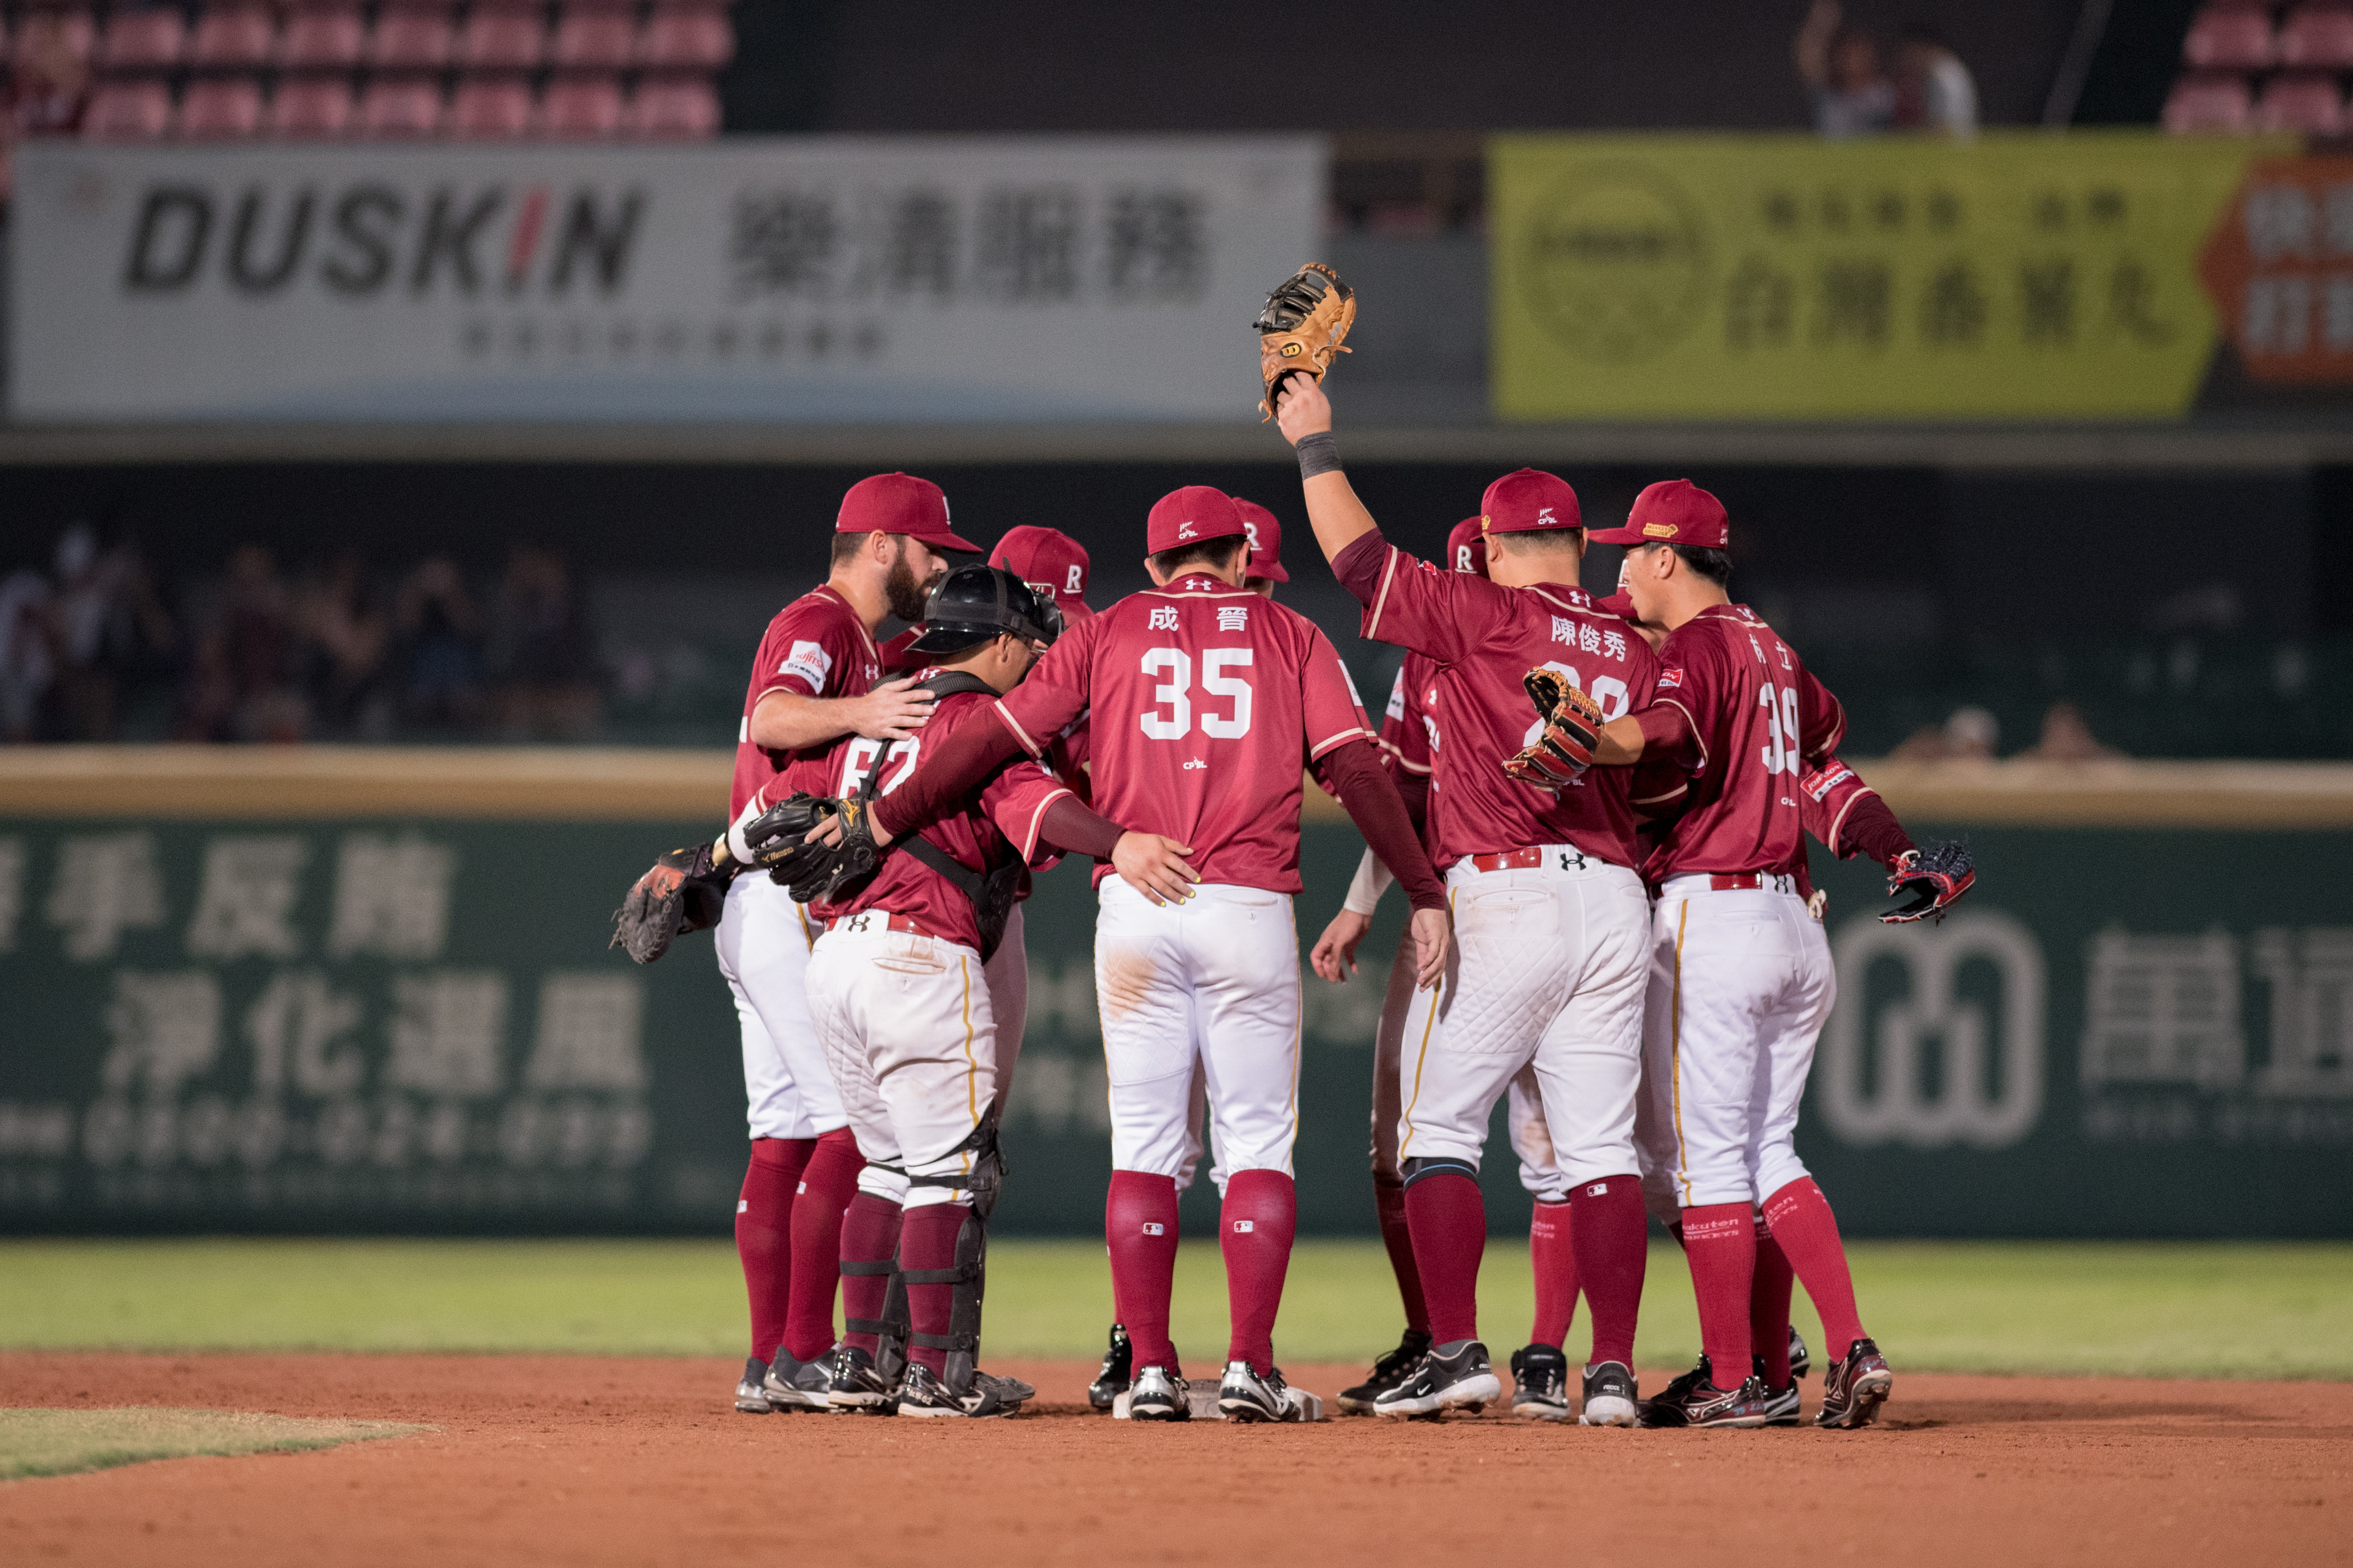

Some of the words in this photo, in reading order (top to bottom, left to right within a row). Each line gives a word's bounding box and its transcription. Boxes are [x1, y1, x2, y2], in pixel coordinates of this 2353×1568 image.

[125, 184, 646, 296] DUSKIN
[1066, 565, 1082, 591] R
[1457, 545, 1473, 571] R
[1550, 615, 1626, 662] 陳俊秀
[1140, 647, 1253, 740] 35
[1759, 682, 1800, 775] 39
